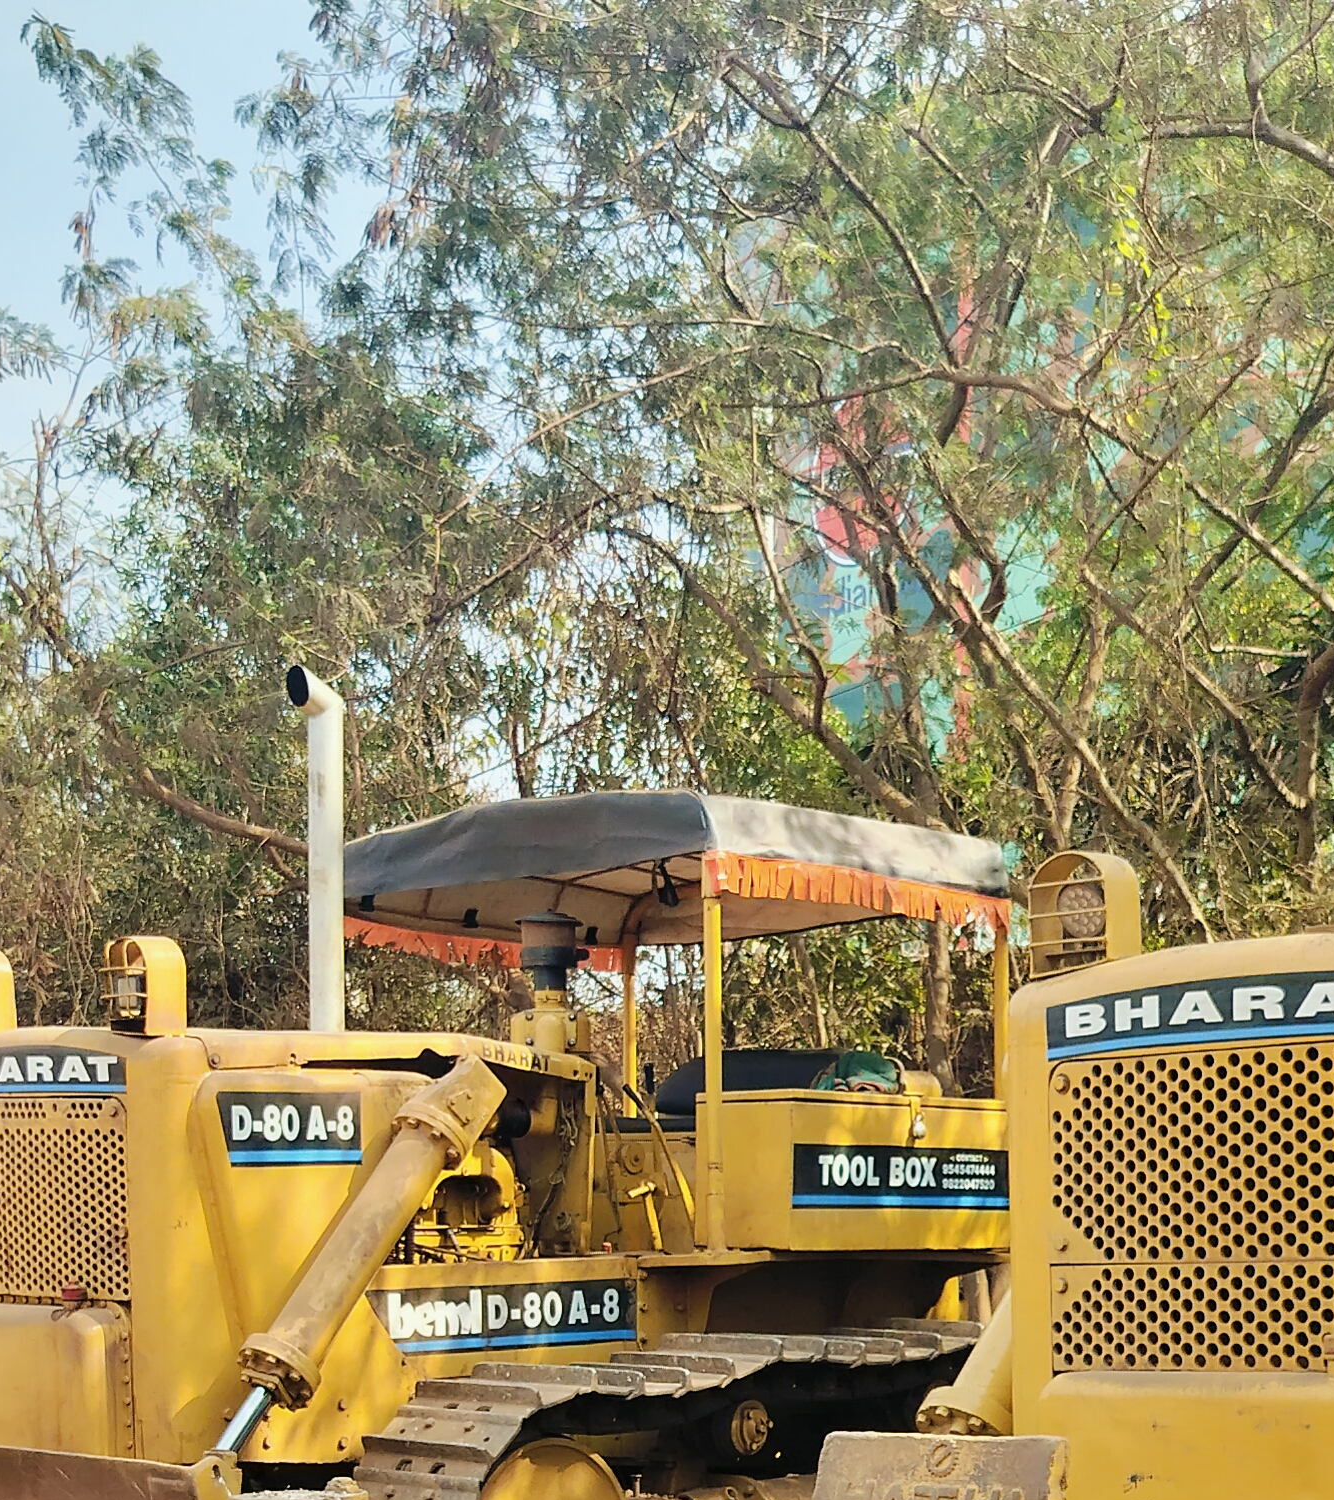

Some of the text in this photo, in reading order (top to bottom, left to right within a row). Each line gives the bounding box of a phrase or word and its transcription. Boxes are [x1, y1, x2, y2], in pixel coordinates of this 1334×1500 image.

[482, 1041, 551, 1072] BHARAT
[230, 1104, 355, 1142] D-80 A-8
[818, 1154, 937, 1187] TOOL BOX
[387, 1288, 621, 1340] beml D-80 A-8
